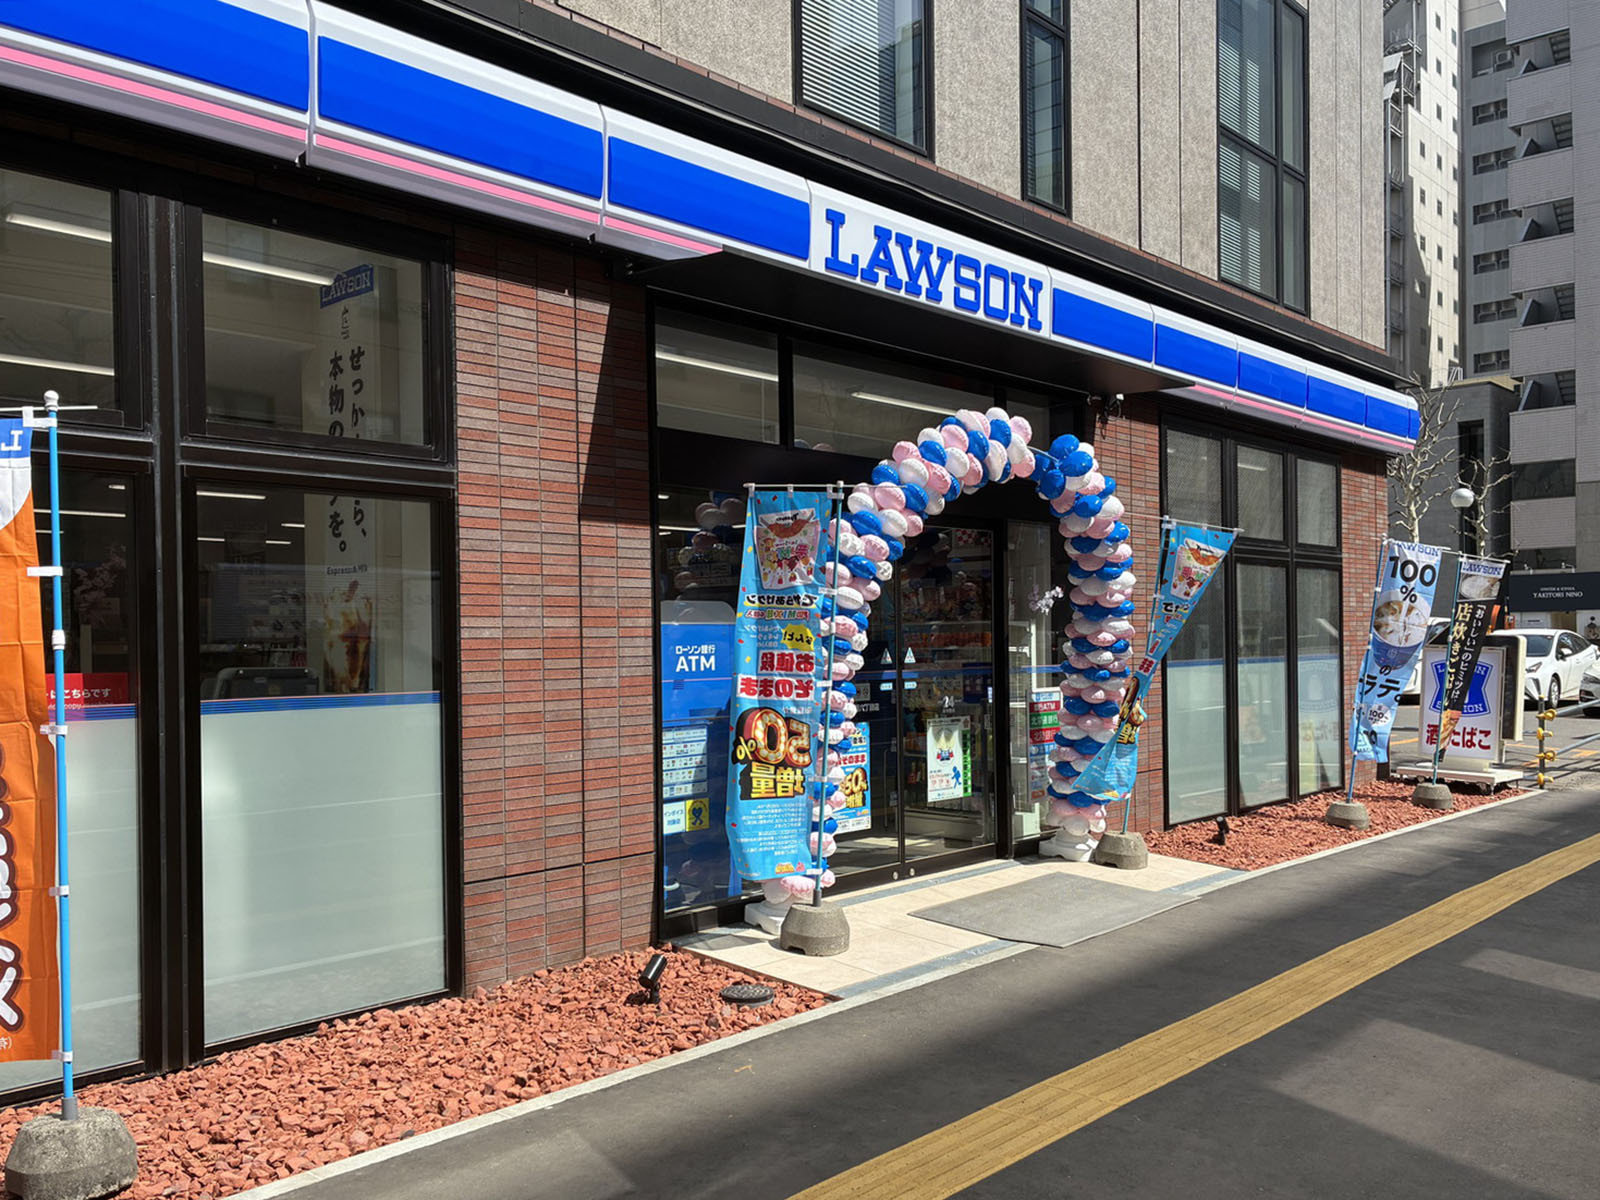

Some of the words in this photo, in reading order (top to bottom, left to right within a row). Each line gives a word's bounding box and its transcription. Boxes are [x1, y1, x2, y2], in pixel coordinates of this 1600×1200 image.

[824, 208, 1043, 332] LAWSON
[321, 271, 372, 303] LAWSON
[1393, 541, 1441, 557] AWSON
[1388, 556, 1438, 587] 100
[1400, 585, 1417, 604] %
[1533, 591, 1564, 599] YAKITORI
[1565, 590, 1583, 598] NINO
[675, 645, 715, 655] ローソン銀行
[675, 655, 716, 672] ATM
[1379, 664, 1392, 676] の
[1436, 700, 1484, 713] SION
